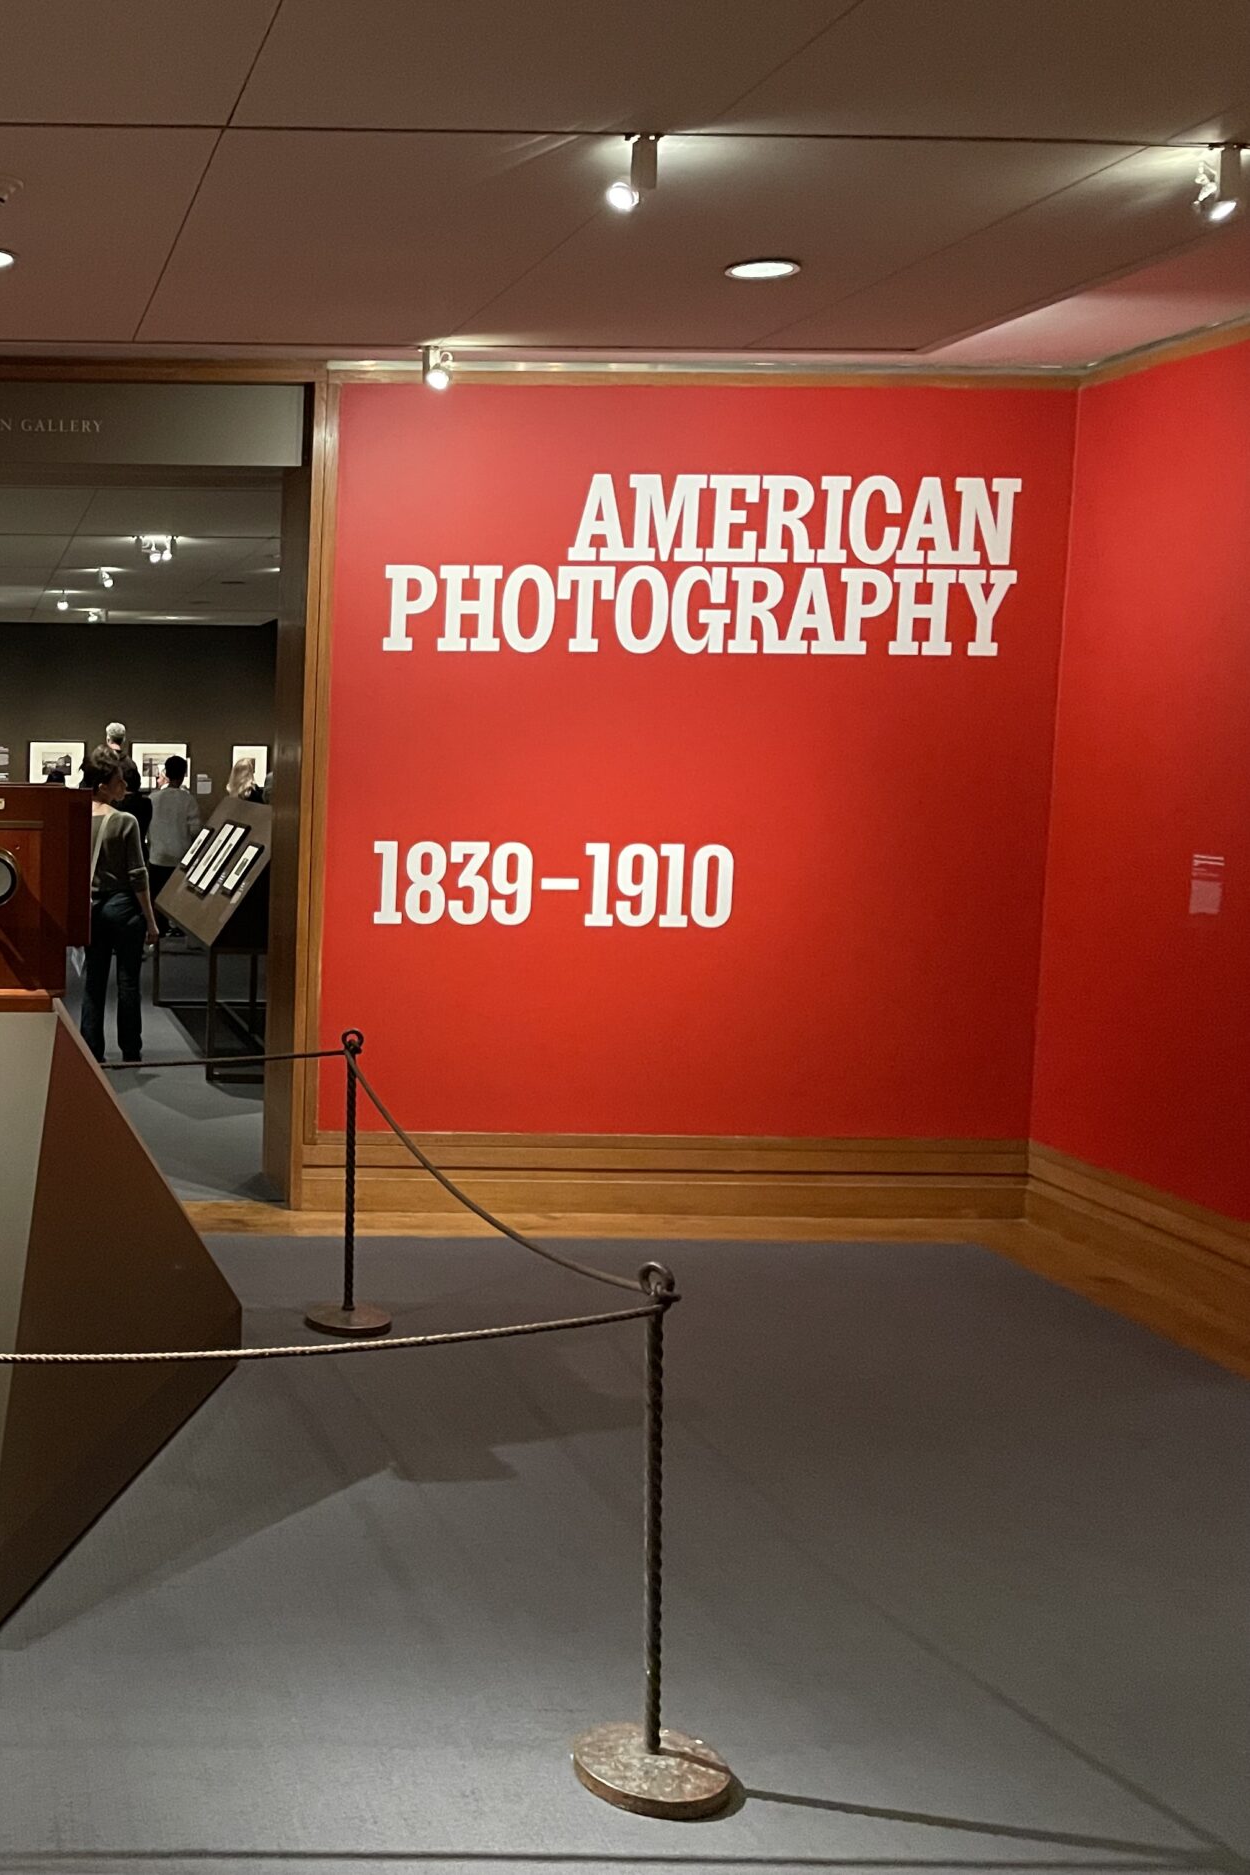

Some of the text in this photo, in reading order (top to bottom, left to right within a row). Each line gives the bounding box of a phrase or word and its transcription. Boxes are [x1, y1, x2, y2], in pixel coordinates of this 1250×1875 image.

[20, 419, 103, 432] GALLERY
[567, 473, 1022, 565] AMERICAN
[382, 564, 1017, 656] PHOTOGRAPHY
